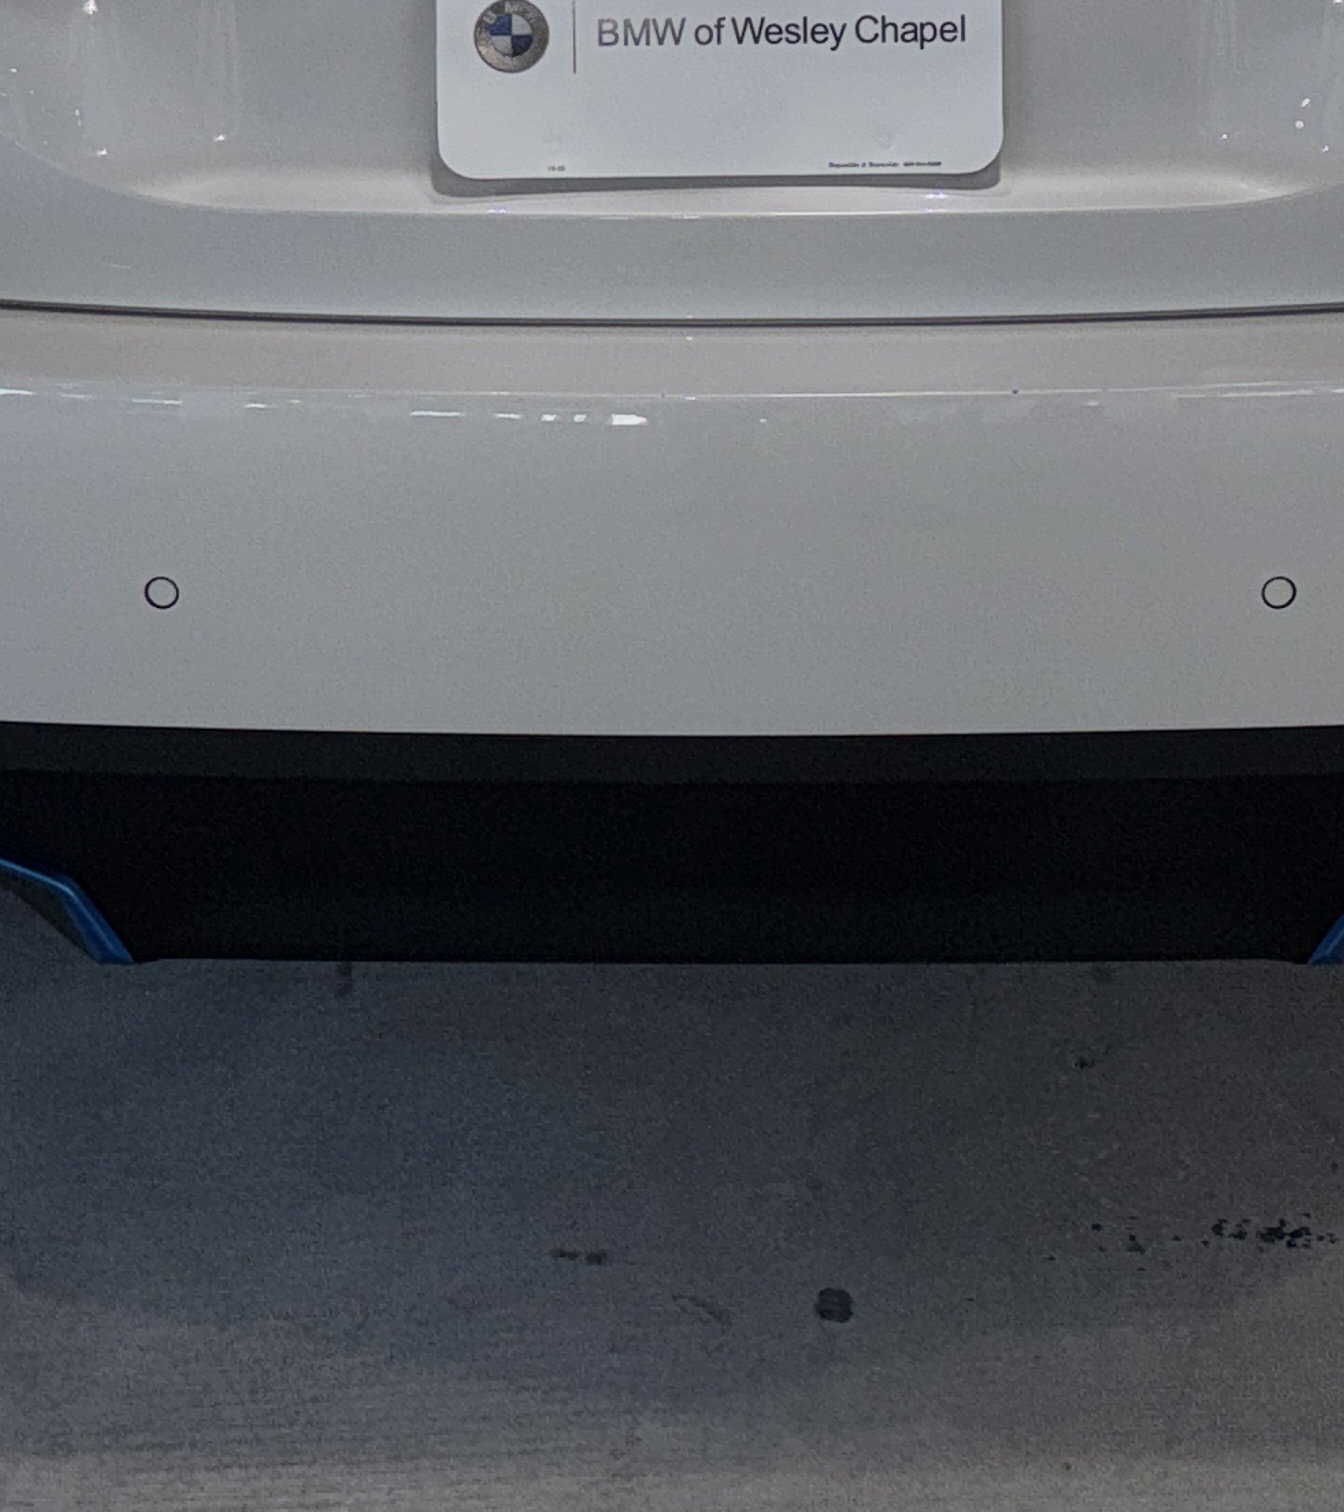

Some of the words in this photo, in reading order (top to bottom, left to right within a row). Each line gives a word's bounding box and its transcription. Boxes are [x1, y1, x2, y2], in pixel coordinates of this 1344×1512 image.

[597, 17, 686, 47] BMW
[694, 16, 726, 46] of
[731, 16, 847, 52] Wesley
[855, 14, 966, 50] Chapel
